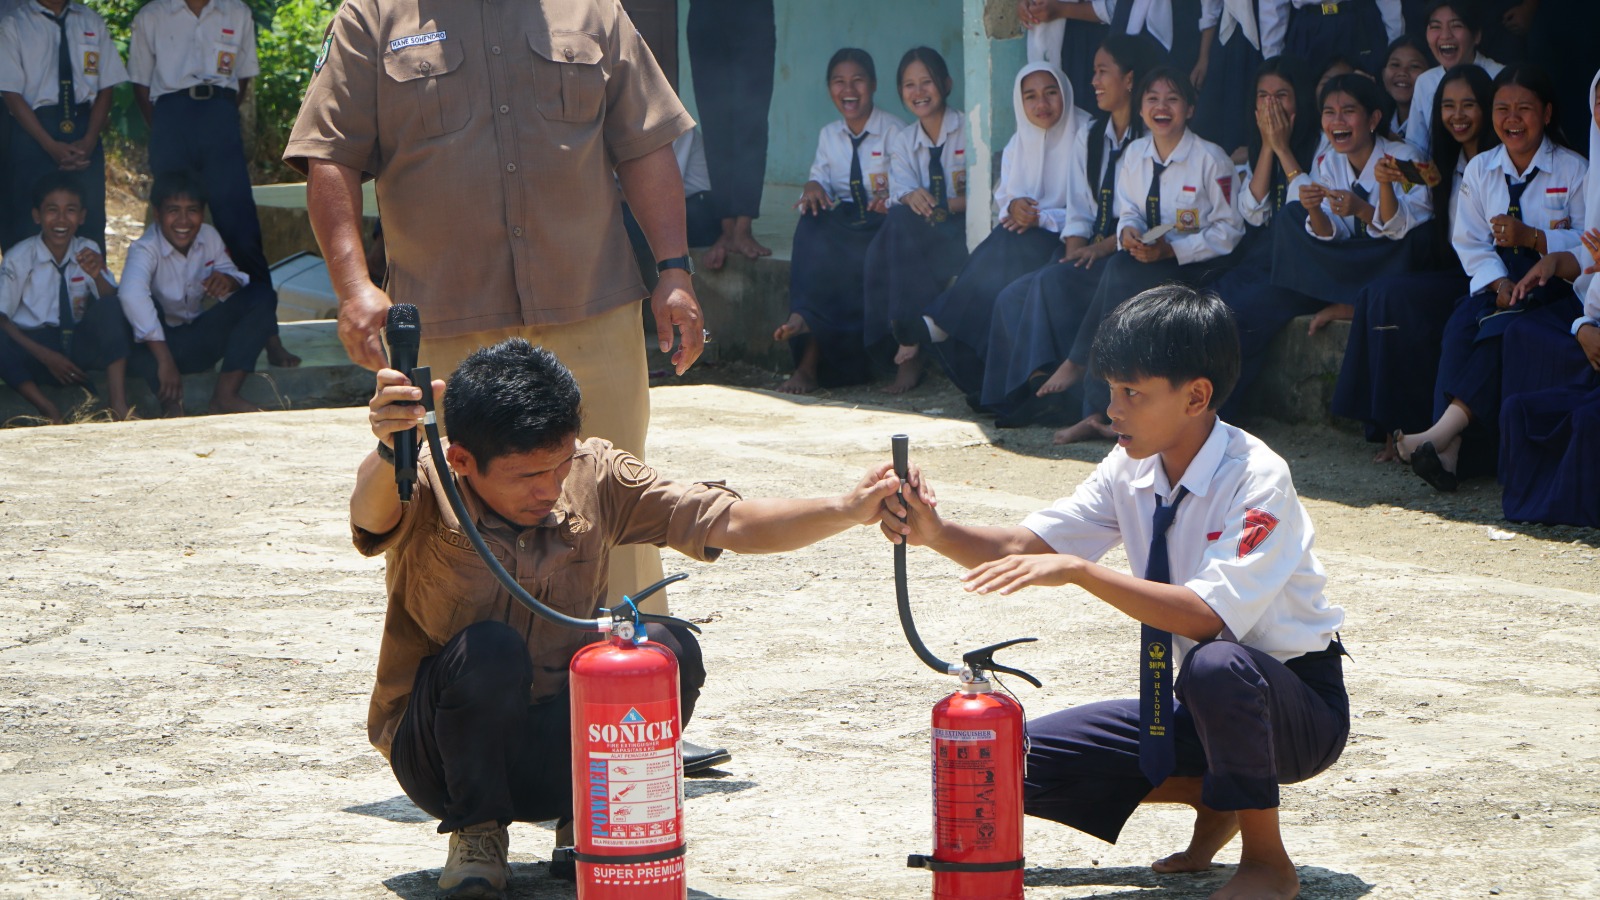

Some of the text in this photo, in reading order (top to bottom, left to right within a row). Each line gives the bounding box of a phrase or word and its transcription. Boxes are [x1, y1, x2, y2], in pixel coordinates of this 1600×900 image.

[1154, 671, 1160, 679] 3
[588, 720, 673, 743] SONICK
[590, 761, 609, 837] POWDER
[594, 866, 634, 879] SUPER
[637, 862, 682, 878] PREMIUM
